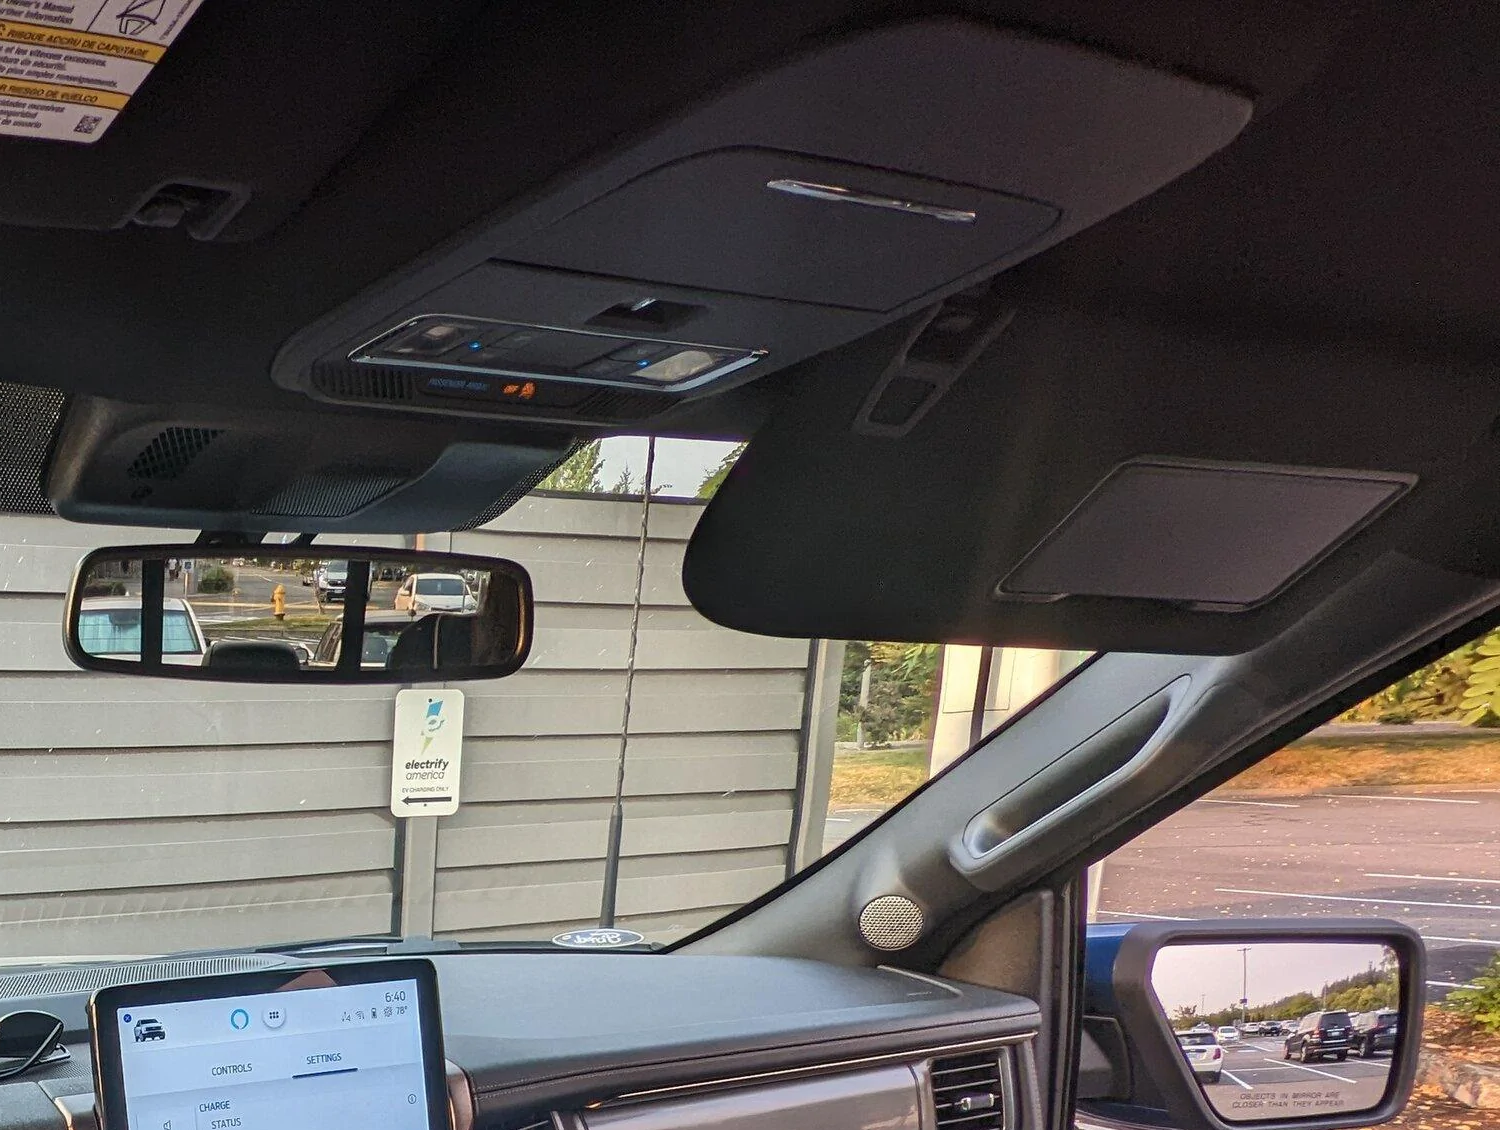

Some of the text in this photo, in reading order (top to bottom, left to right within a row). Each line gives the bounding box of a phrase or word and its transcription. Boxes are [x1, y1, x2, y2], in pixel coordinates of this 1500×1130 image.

[405, 758, 449, 771] electrify
[406, 770, 445, 780] america
[385, 990, 406, 1003] 6:40
[306, 1052, 342, 1065] SETTINGS
[211, 1062, 253, 1076] CONTROLS
[1239, 1092, 1276, 1100] OBJECTS
[199, 1099, 231, 1113] CHARGE
[1232, 1101, 1264, 1109] CLOSER
[211, 1117, 242, 1130] STATUS
